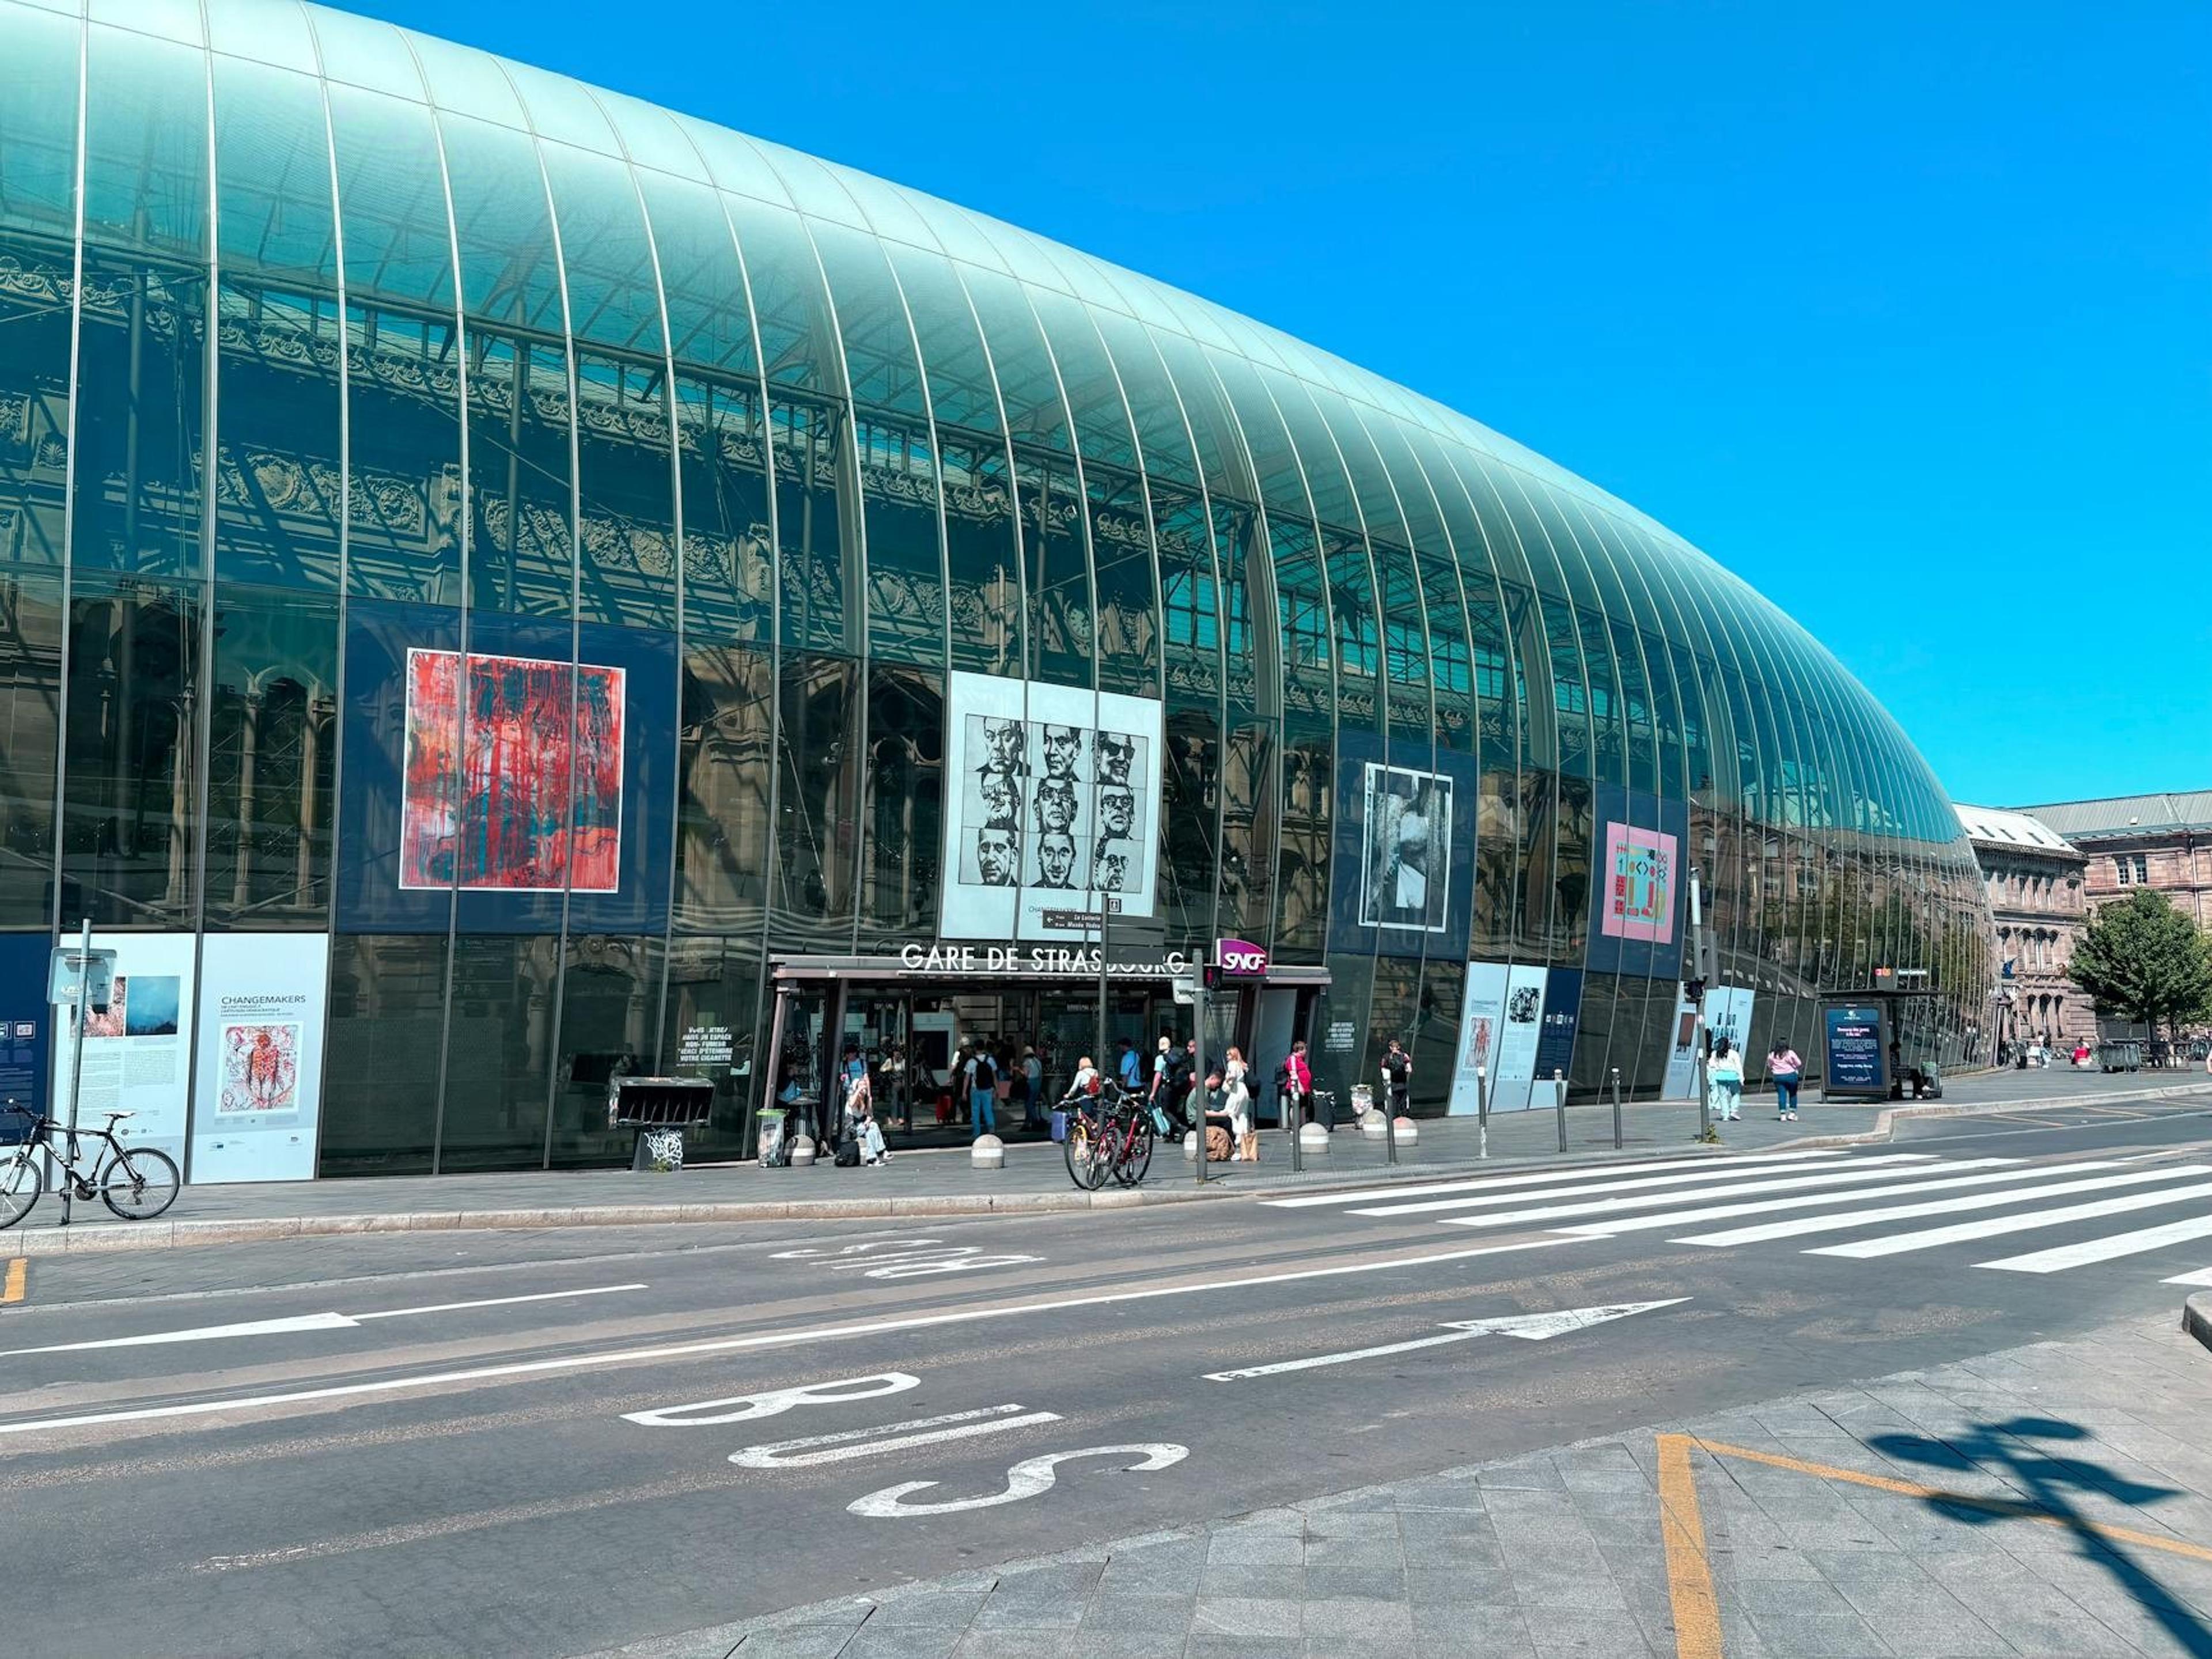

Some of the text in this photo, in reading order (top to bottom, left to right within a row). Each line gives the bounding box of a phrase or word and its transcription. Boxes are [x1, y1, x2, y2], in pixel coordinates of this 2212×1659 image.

[901, 944, 1185, 973] GARE DE STRASG
[1222, 952, 1266, 971] SNCF
[221, 995, 306, 1005] CHANGEMAKERS
[768, 1239, 1048, 1279] BUS
[619, 1371, 1191, 1518] BUS
